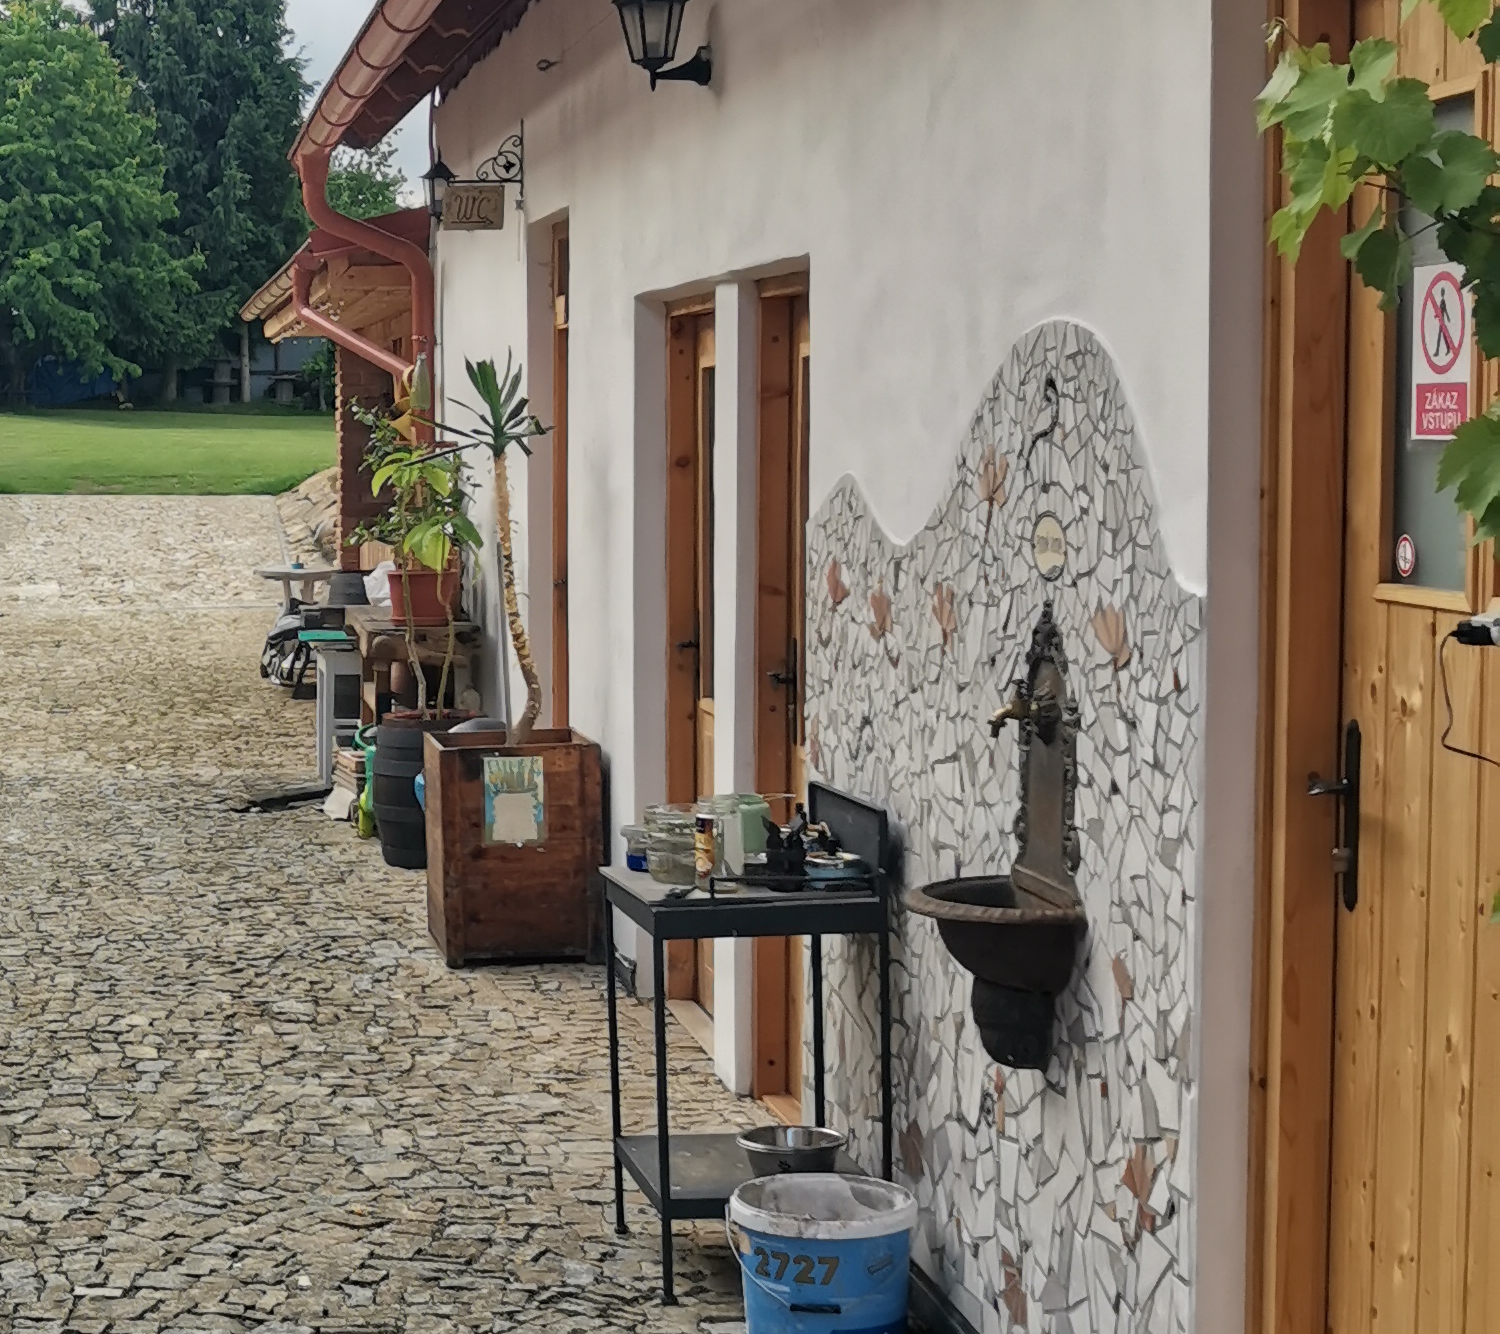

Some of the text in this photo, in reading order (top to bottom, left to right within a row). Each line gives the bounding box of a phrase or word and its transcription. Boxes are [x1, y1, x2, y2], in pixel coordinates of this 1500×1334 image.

[454, 195, 491, 220] WC
[1424, 388, 1459, 410] ZÁKAZ
[1422, 411, 1462, 430] VSTUPU
[754, 1247, 840, 1285] 2727
